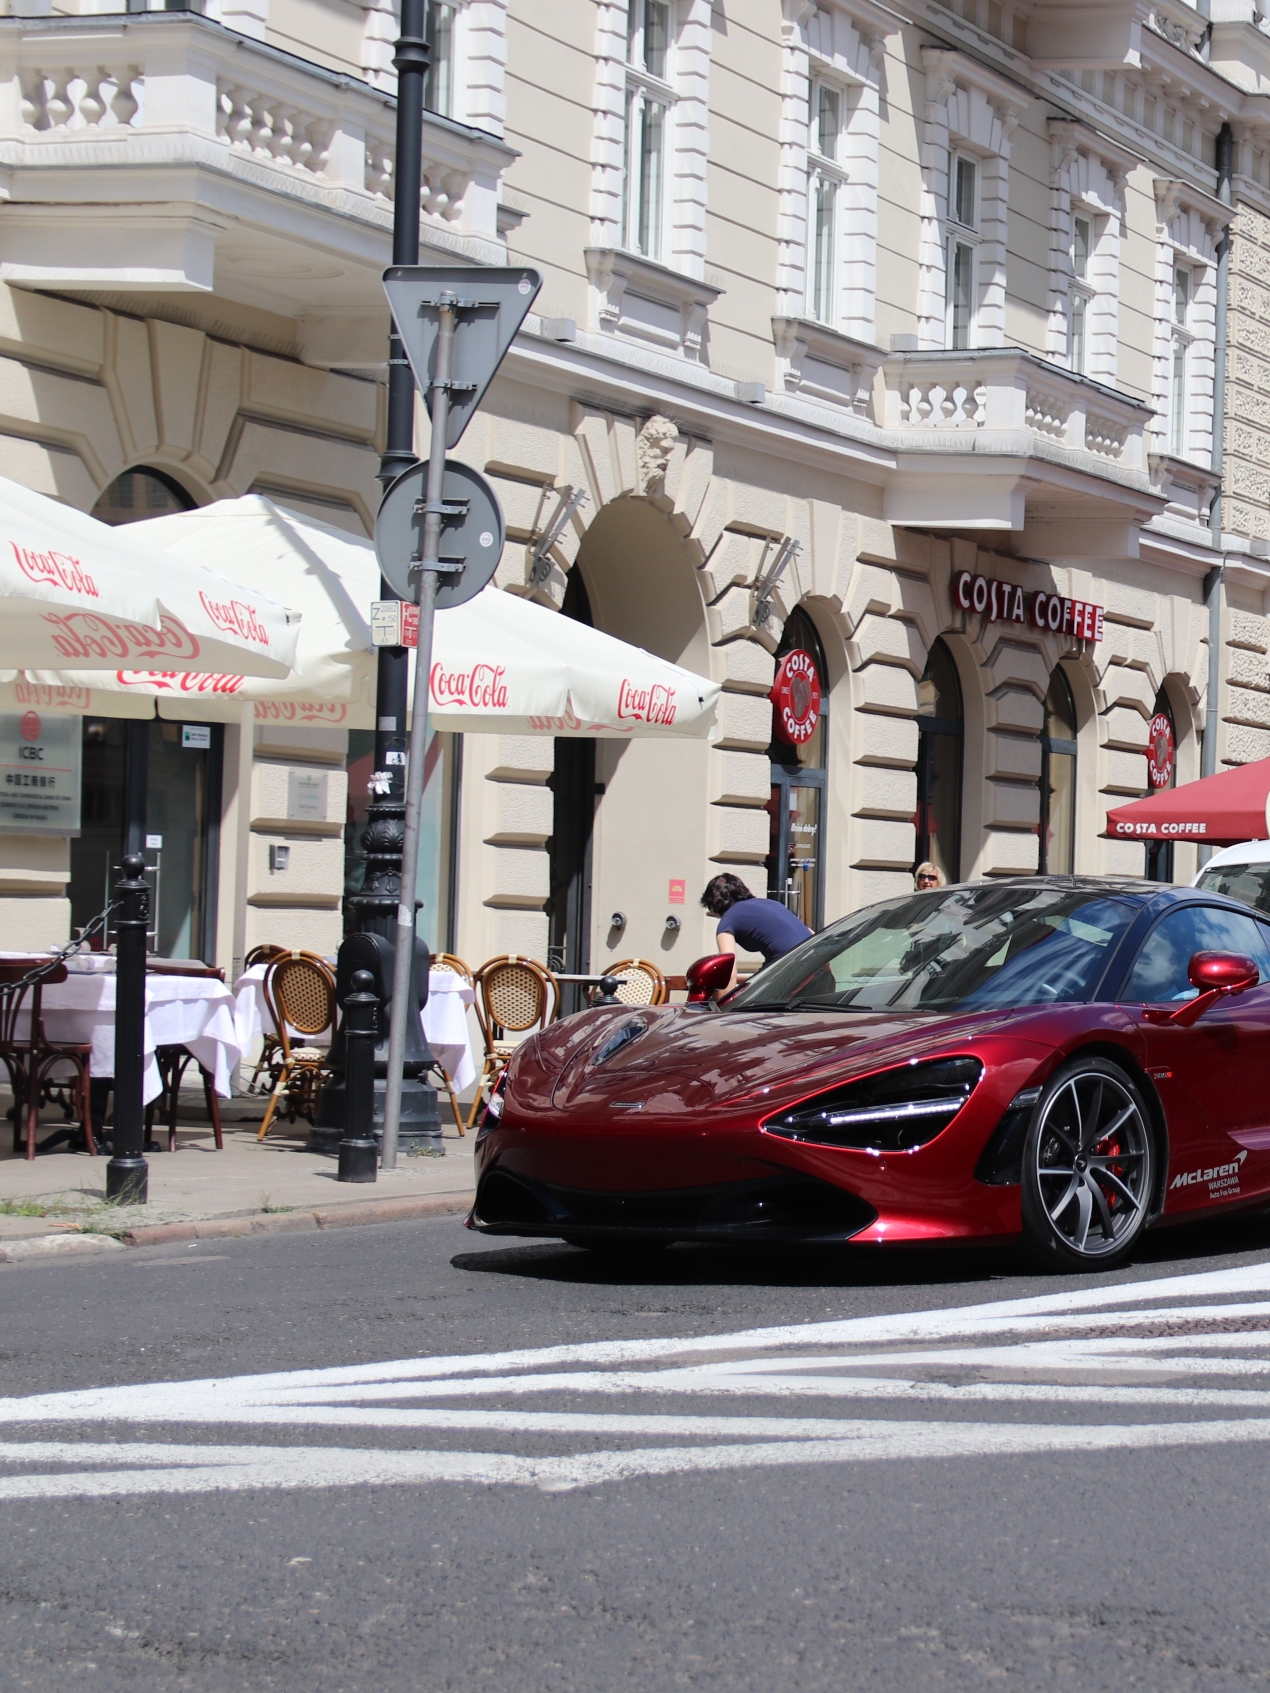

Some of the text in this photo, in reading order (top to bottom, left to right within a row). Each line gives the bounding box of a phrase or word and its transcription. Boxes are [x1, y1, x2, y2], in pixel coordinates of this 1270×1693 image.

[958, 571, 1104, 641] COSTA COFFEE
[786, 654, 815, 682] COSTA
[783, 707, 817, 740] COFFEE
[1152, 717, 1171, 739] COSTA
[18, 746, 44, 760] ICBC
[1149, 760, 1172, 785] COFFEE
[1116, 823, 1207, 834] COSTA COFFEE
[1169, 1162, 1239, 1190] McLaren
[1208, 1176, 1239, 1190] WARSZAWA
[1209, 1186, 1241, 1199] Auto Fus Group
